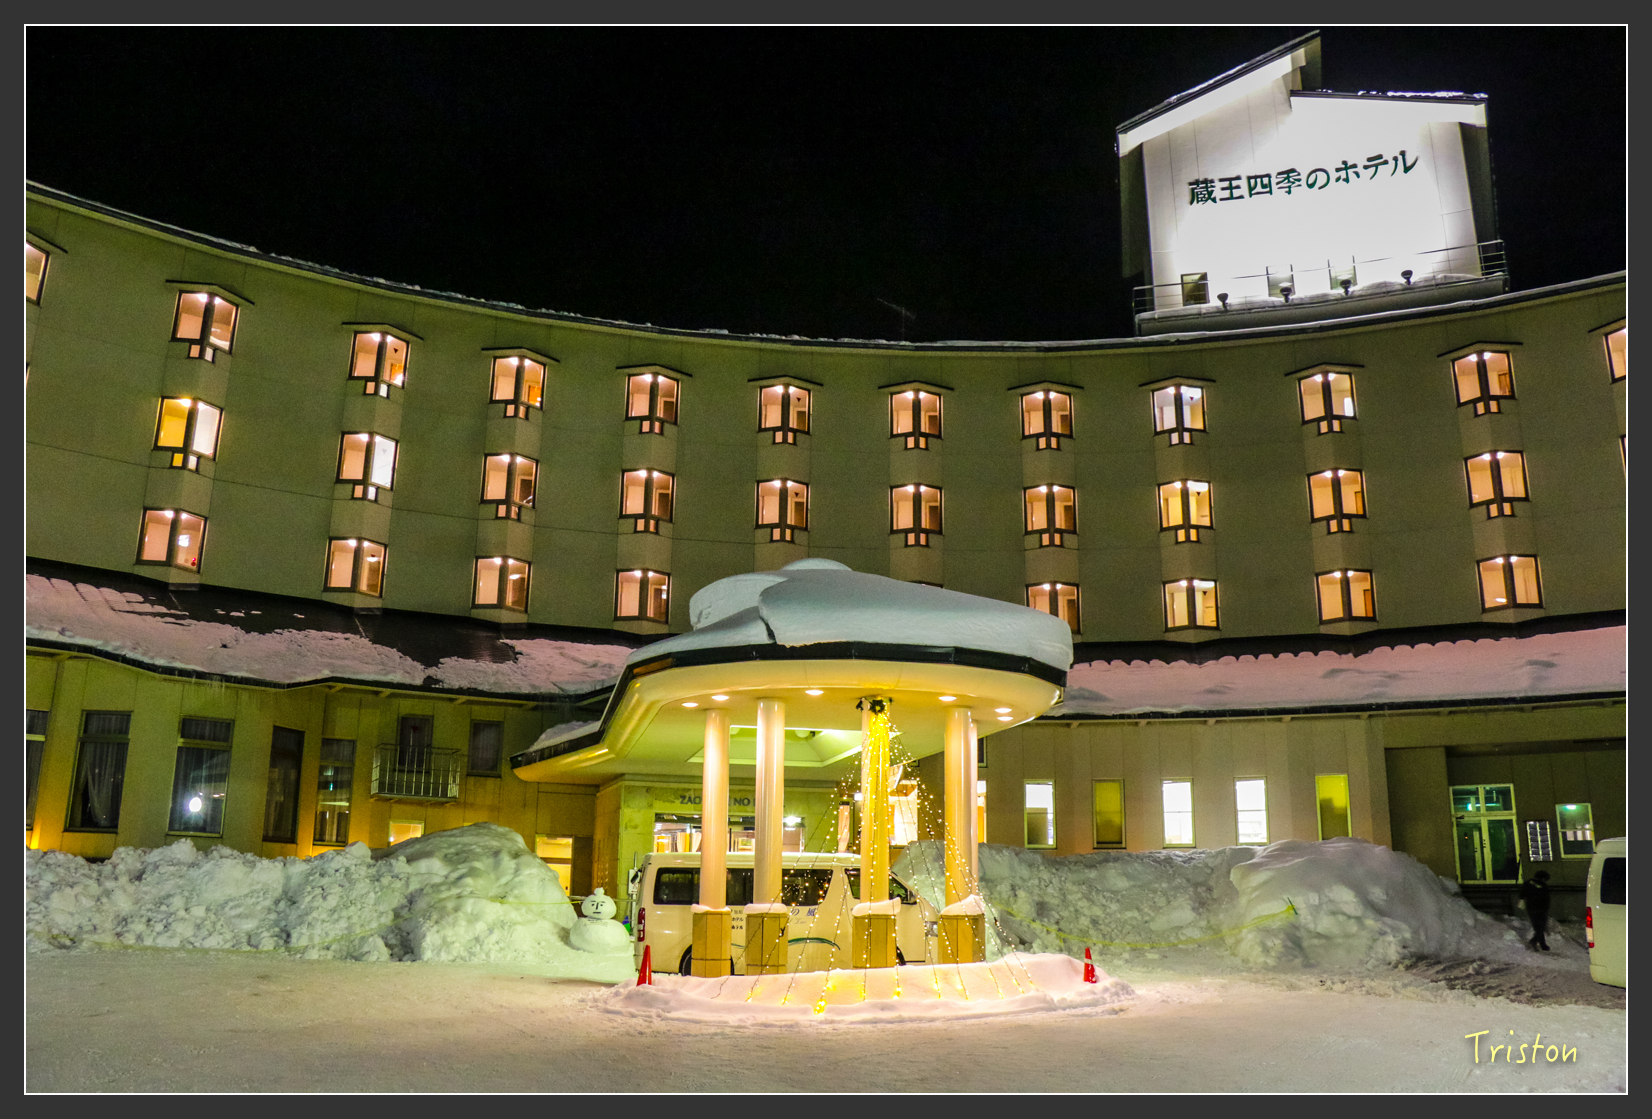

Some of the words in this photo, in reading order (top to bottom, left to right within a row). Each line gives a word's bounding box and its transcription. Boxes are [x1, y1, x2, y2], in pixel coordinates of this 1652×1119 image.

[1188, 150, 1420, 206] 蔵王四季のホテル
